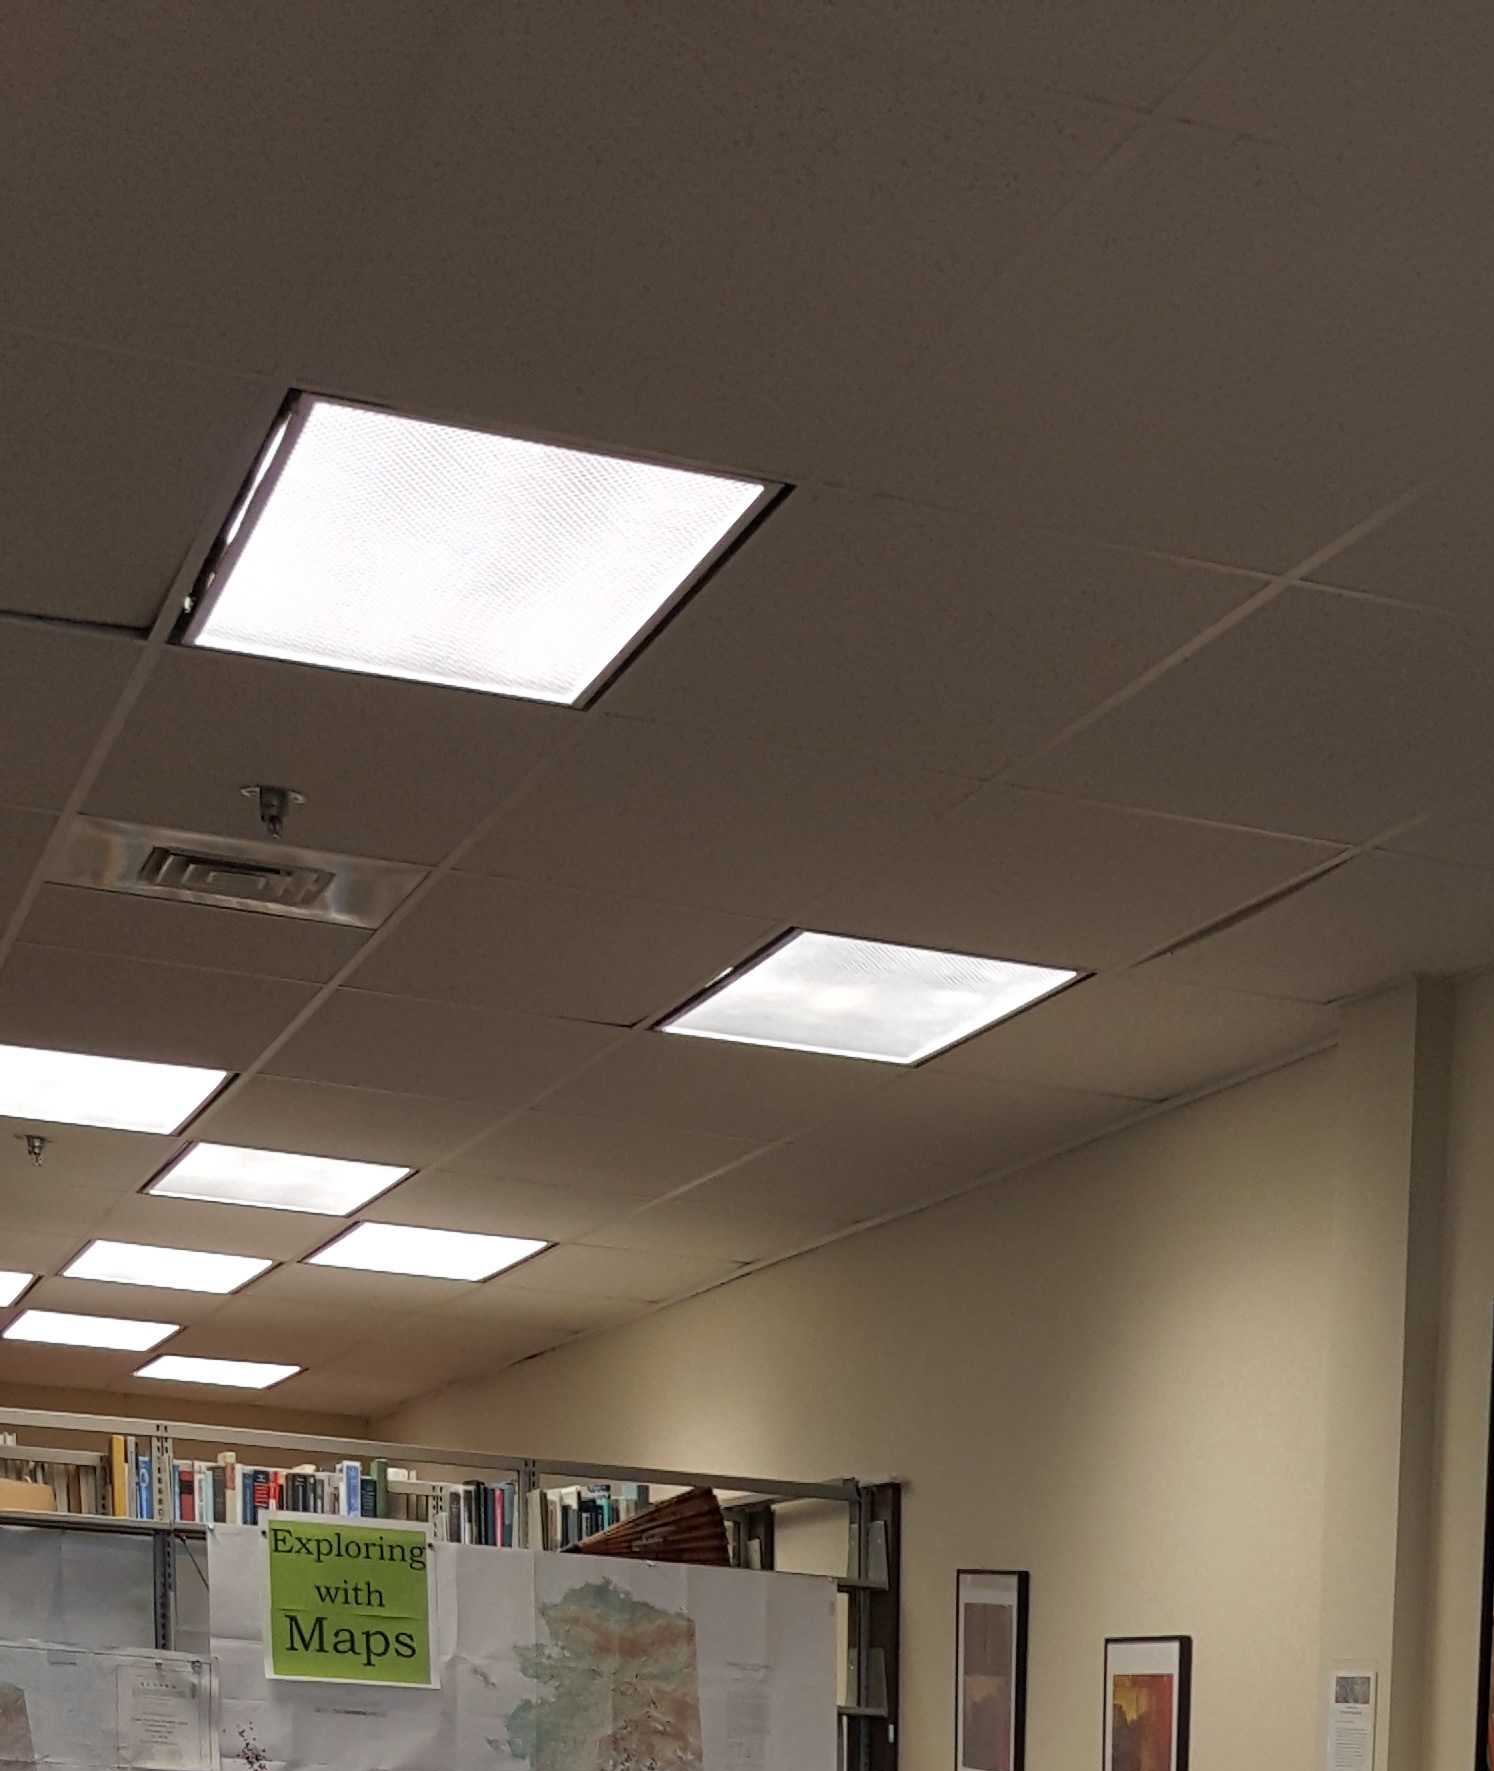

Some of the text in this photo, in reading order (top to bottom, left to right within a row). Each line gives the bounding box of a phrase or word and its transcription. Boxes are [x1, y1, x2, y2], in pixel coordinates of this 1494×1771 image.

[270, 1528, 427, 1571] Exploring
[314, 1579, 386, 1608] with
[284, 1614, 417, 1667] Maps
